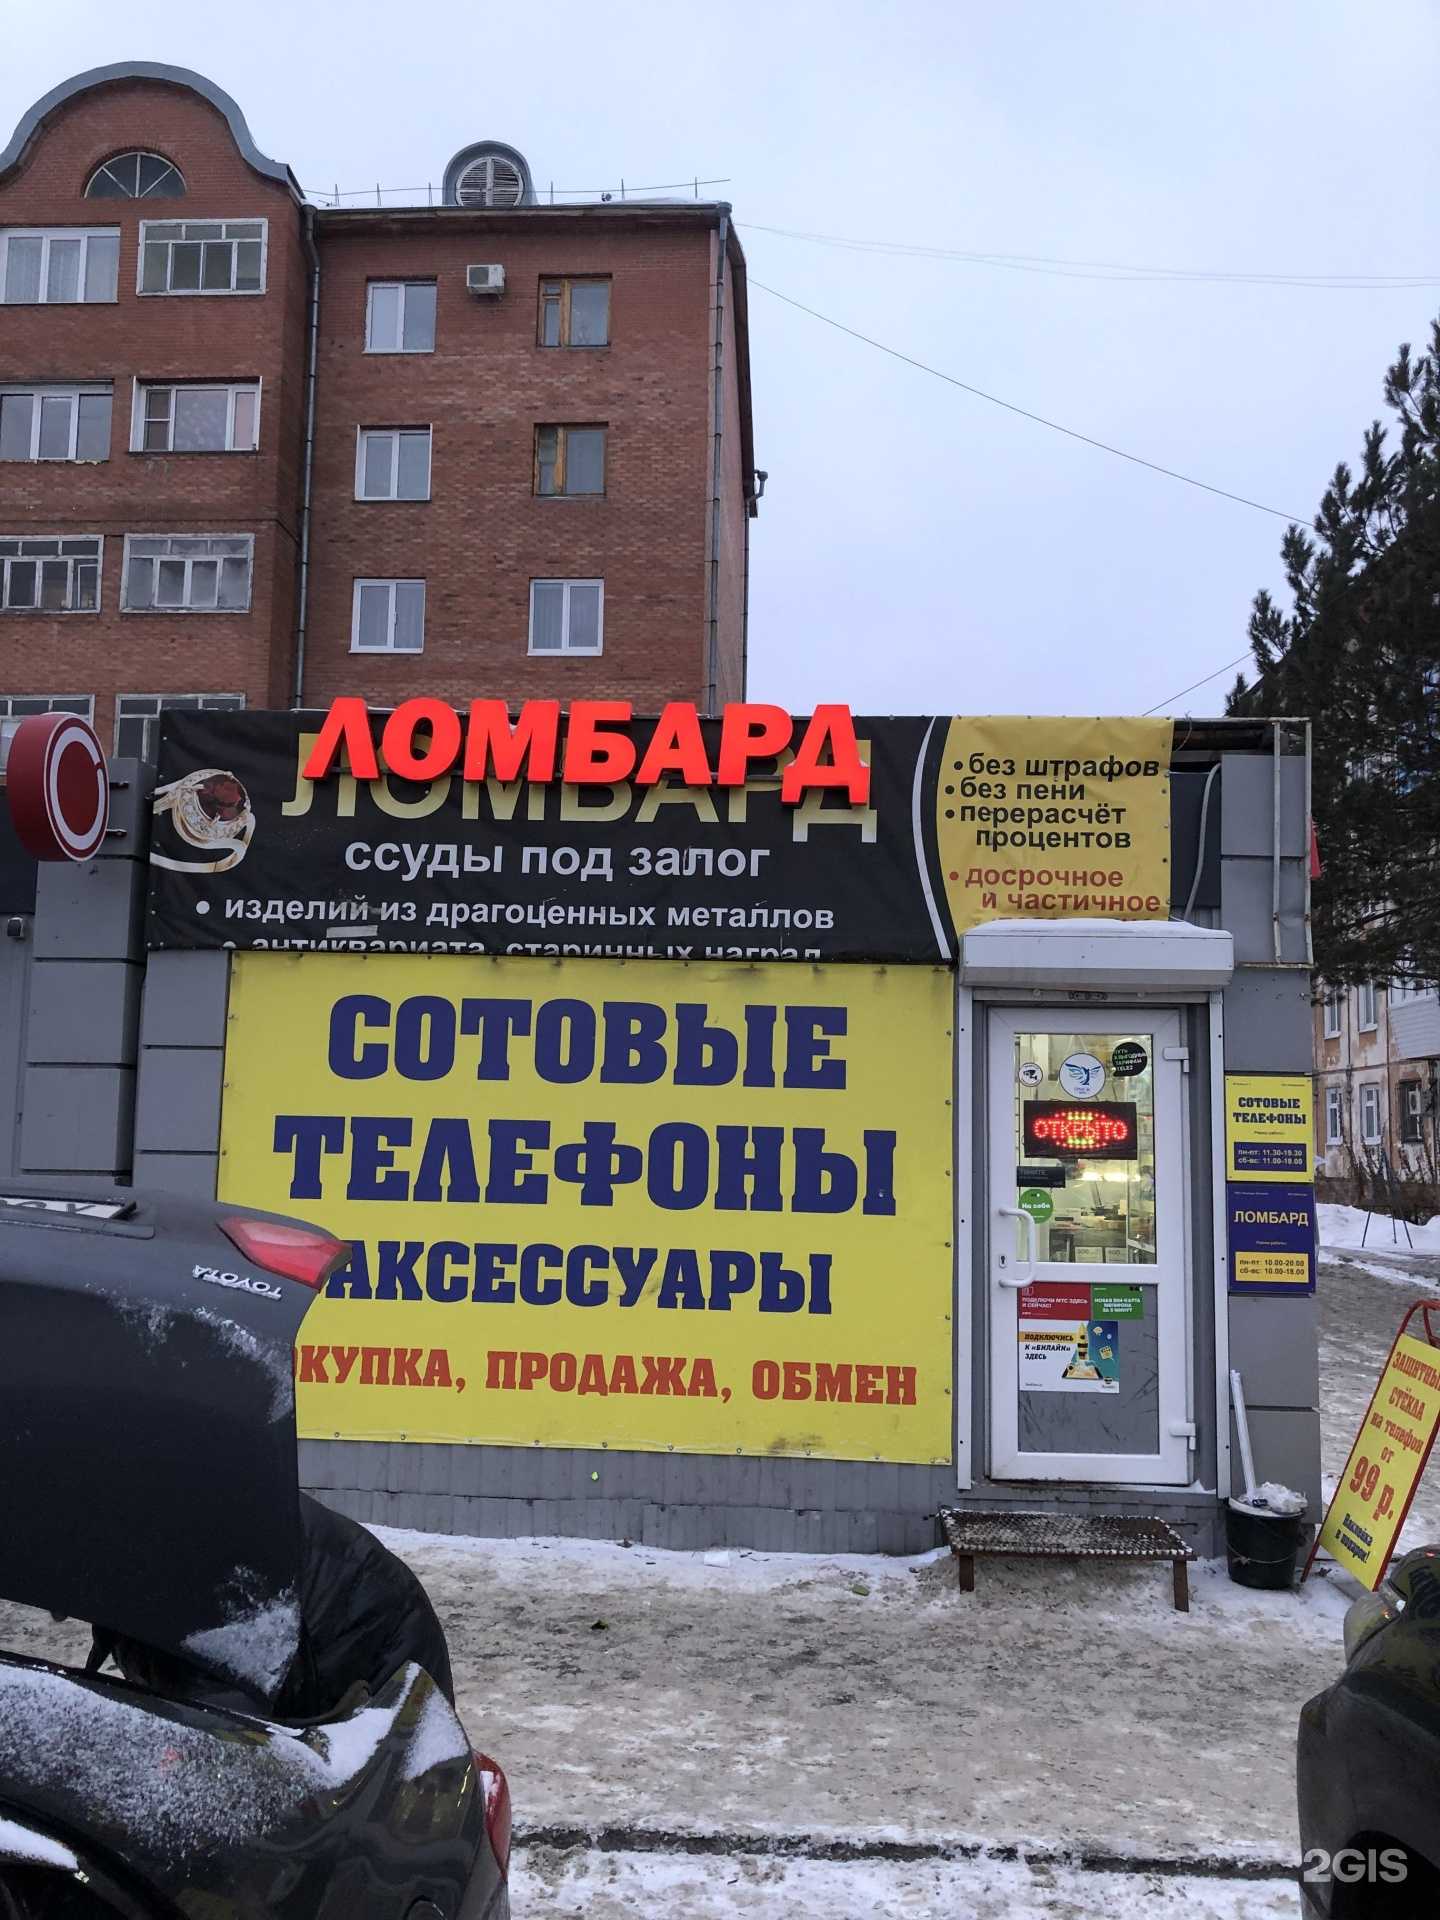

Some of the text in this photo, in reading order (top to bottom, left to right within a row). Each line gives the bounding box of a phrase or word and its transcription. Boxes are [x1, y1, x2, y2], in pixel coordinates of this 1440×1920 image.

[302, 696, 871, 806] ЛОМБАРД
[969, 753, 1160, 782] без штрафов
[960, 776, 1085, 800] без пени
[960, 803, 1126, 829] перерасчёт
[976, 829, 1132, 852] процентов
[345, 841, 771, 882] ссуды под залог
[965, 867, 1124, 890] досрочное
[225, 894, 834, 929] изделий из драгоценных металлов
[1007, 893, 1161, 912] частичное
[327, 994, 848, 1090] СОТОВЫЕ
[1238, 1097, 1301, 1109] СОТОВЫЕ
[1033, 1120, 1128, 1141] ОТКРЫТО
[1232, 1112, 1307, 1125] ТЕЛЕФОНЫ
[272, 1114, 897, 1216] ТЕЛЕФОНЫ
[1234, 1210, 1309, 1227] ЛОМБАРД
[192, 1264, 282, 1300] TOYOTA
[325, 1239, 833, 1314] АКСЕССУАРЫ
[1024, 1333, 1074, 1342] ПОДКЛЮЧИСЬ
[293, 1345, 918, 1406] КУПКА, ПРОДАЖА, ОБМЕН
[1388, 1386, 1426, 1422] СТЁКЛА
[1370, 1412, 1425, 1455] на телефон
[1380, 1446, 1394, 1463] от
[1349, 1456, 1395, 1522] 99 р.
